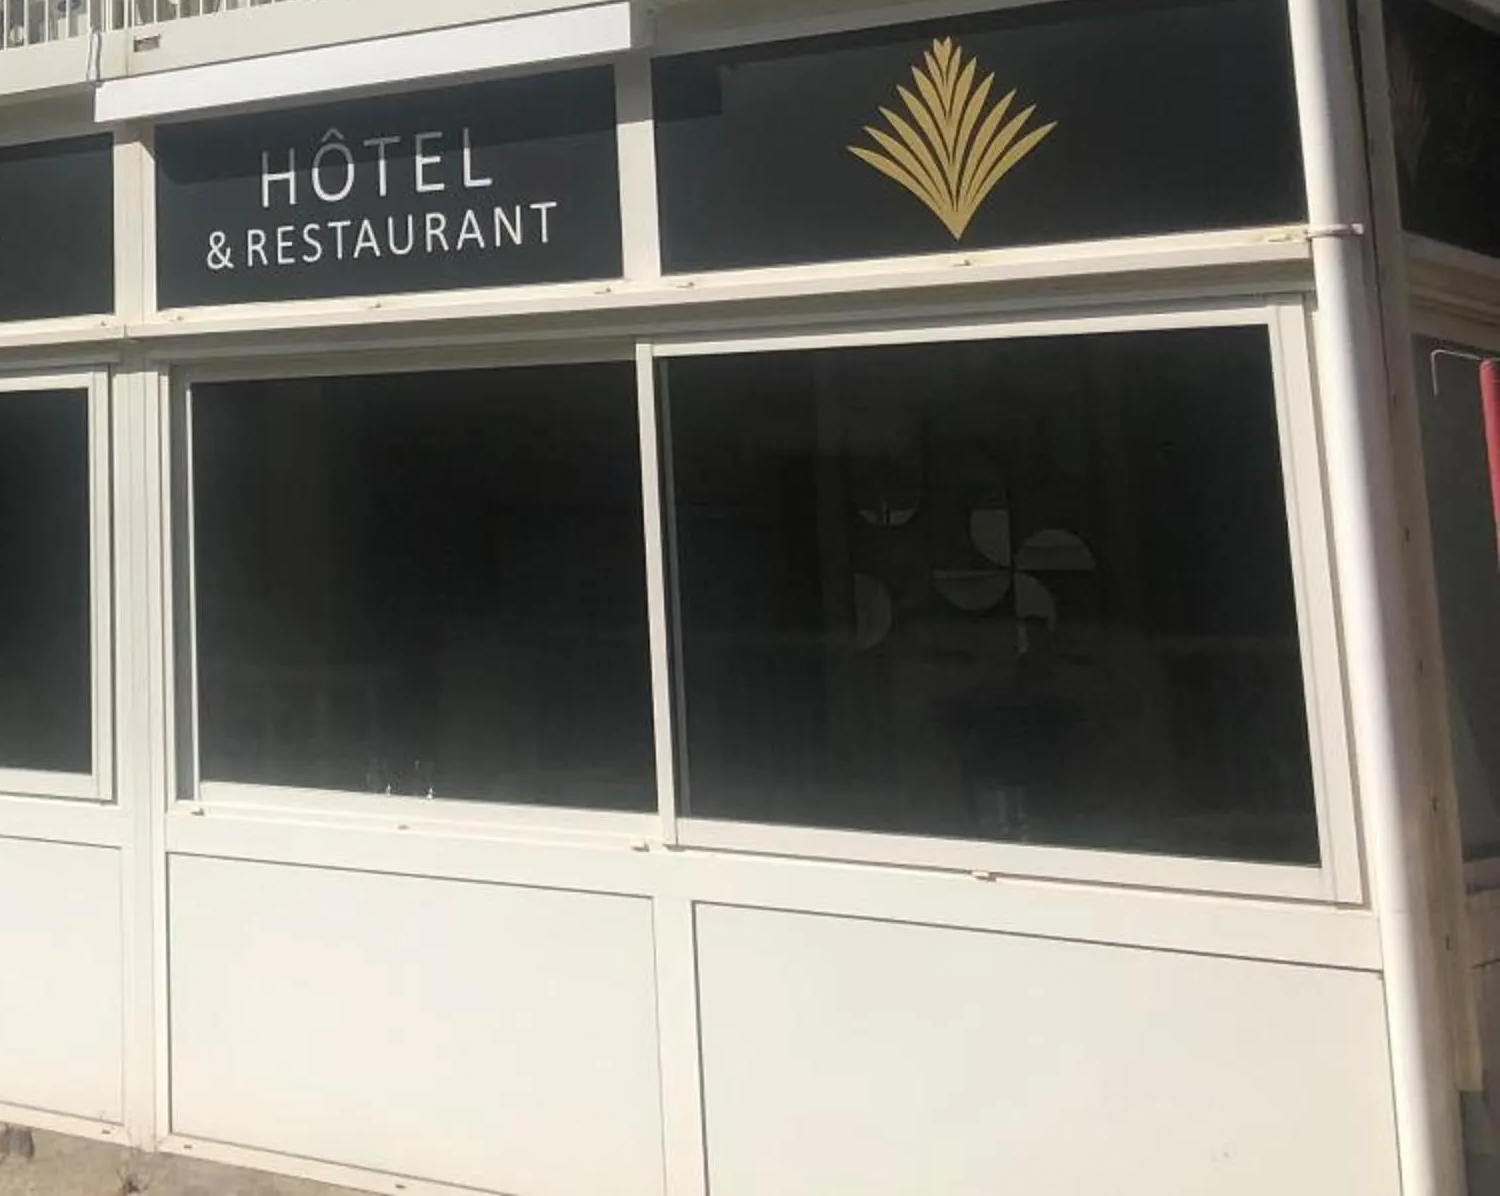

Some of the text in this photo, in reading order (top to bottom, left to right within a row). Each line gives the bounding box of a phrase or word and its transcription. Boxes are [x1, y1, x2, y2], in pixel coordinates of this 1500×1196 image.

[261, 128, 493, 208] HÔTEL
[206, 201, 557, 271] & RESTAURANT
